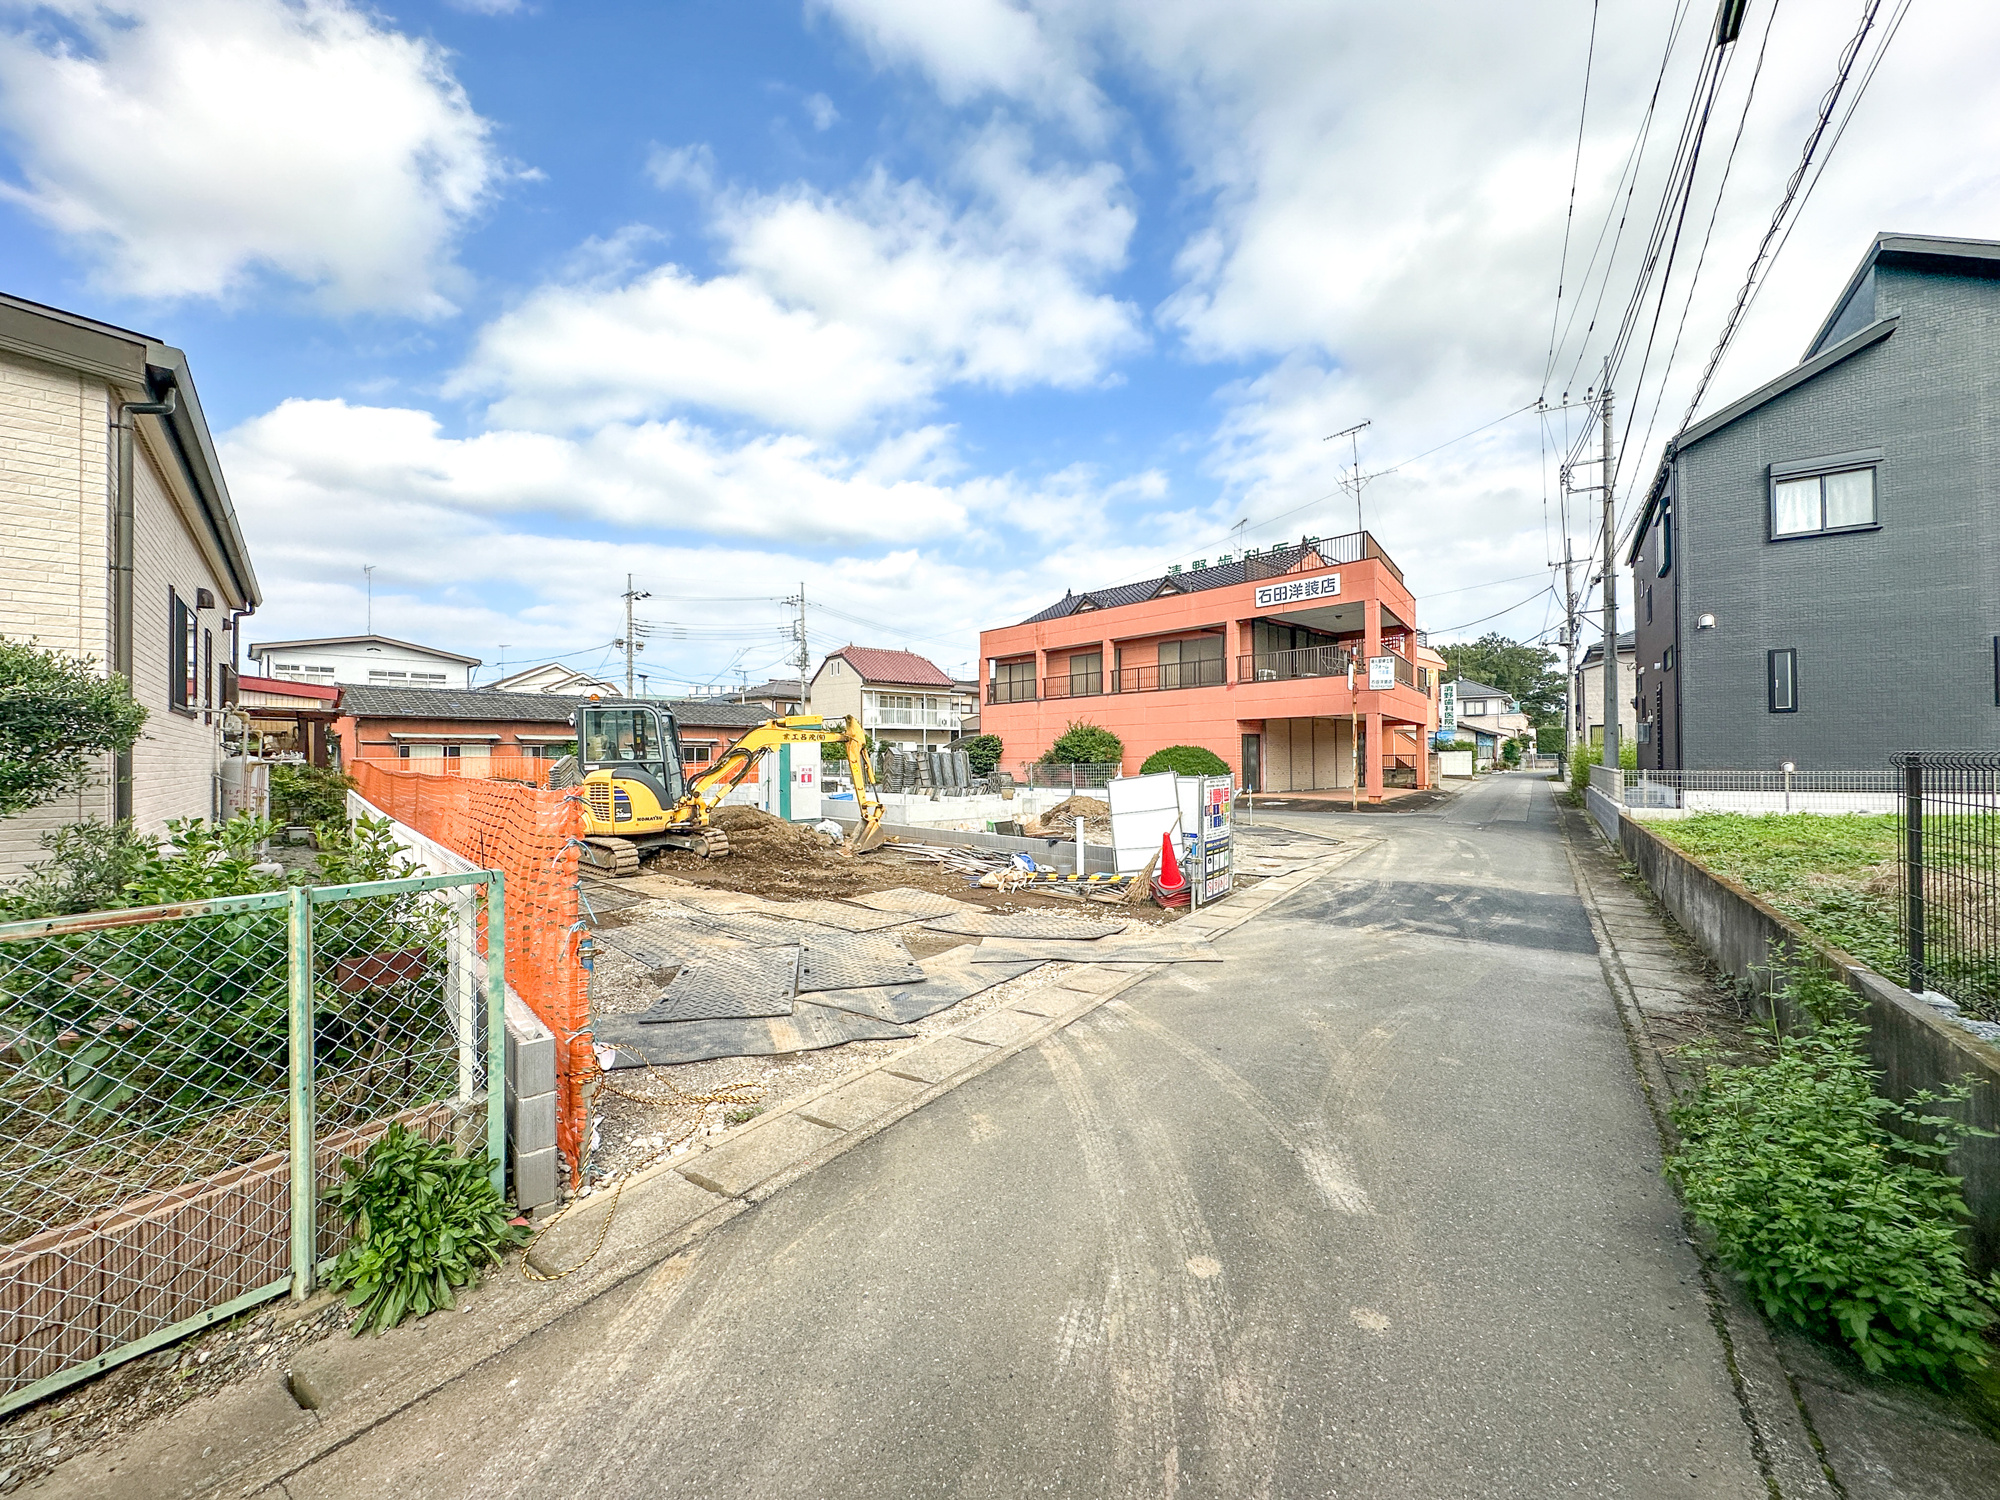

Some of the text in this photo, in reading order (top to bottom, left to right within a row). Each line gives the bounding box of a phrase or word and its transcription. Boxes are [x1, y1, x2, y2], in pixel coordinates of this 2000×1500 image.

[1258, 577, 1336, 604] 石田洋装店
